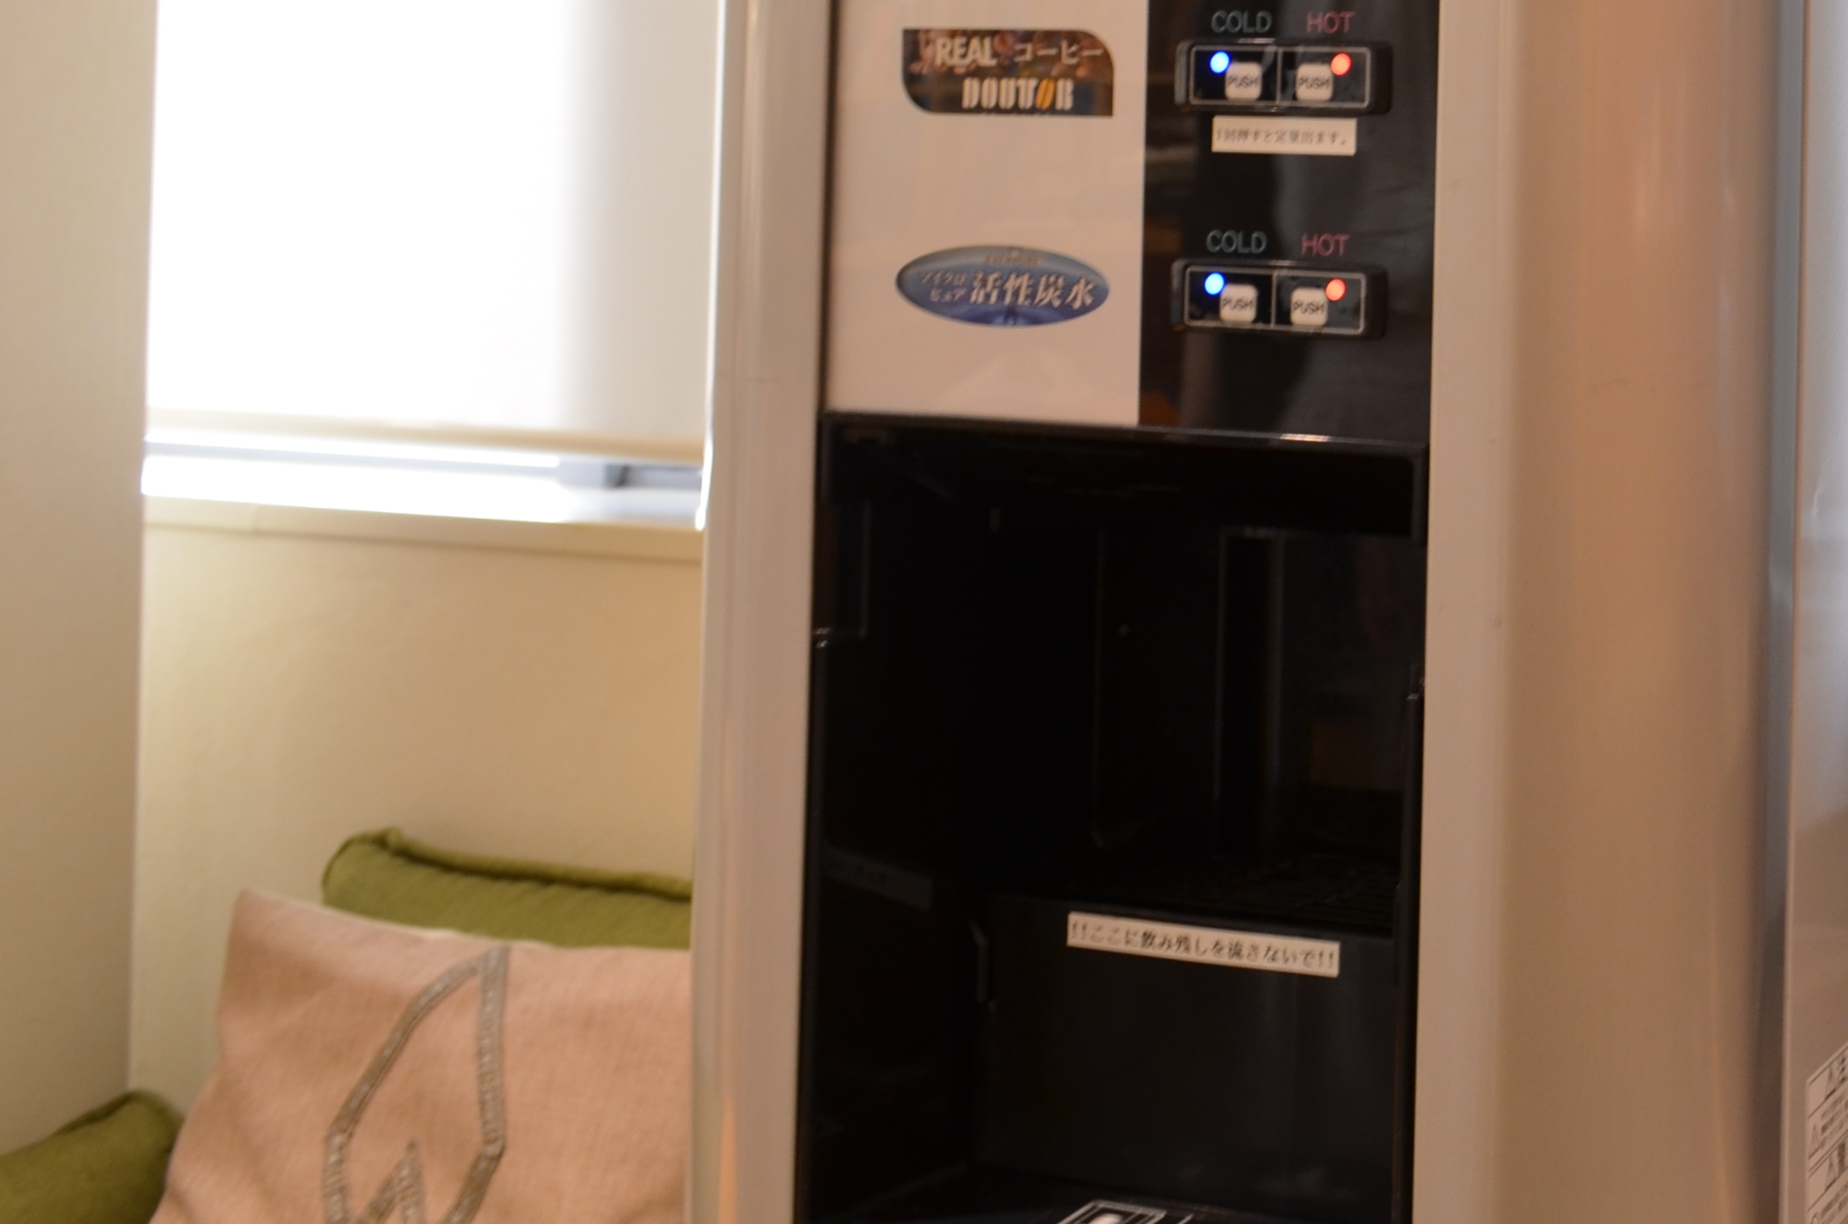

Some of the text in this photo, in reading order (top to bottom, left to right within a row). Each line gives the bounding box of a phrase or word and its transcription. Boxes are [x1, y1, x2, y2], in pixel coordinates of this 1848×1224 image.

[1211, 10, 1273, 33] COLD
[1306, 10, 1356, 34] HOT
[935, 36, 1103, 66] REAL コーヒー
[1227, 74, 1259, 88] PUSH
[1298, 76, 1330, 89] PUSH
[962, 77, 1073, 110] DOUTOR
[1206, 229, 1267, 254] COLD
[1301, 233, 1350, 257] HOT
[969, 270, 1097, 310] 活性炭水
[1222, 297, 1253, 311] PUSH
[1292, 300, 1325, 315] PUSH
